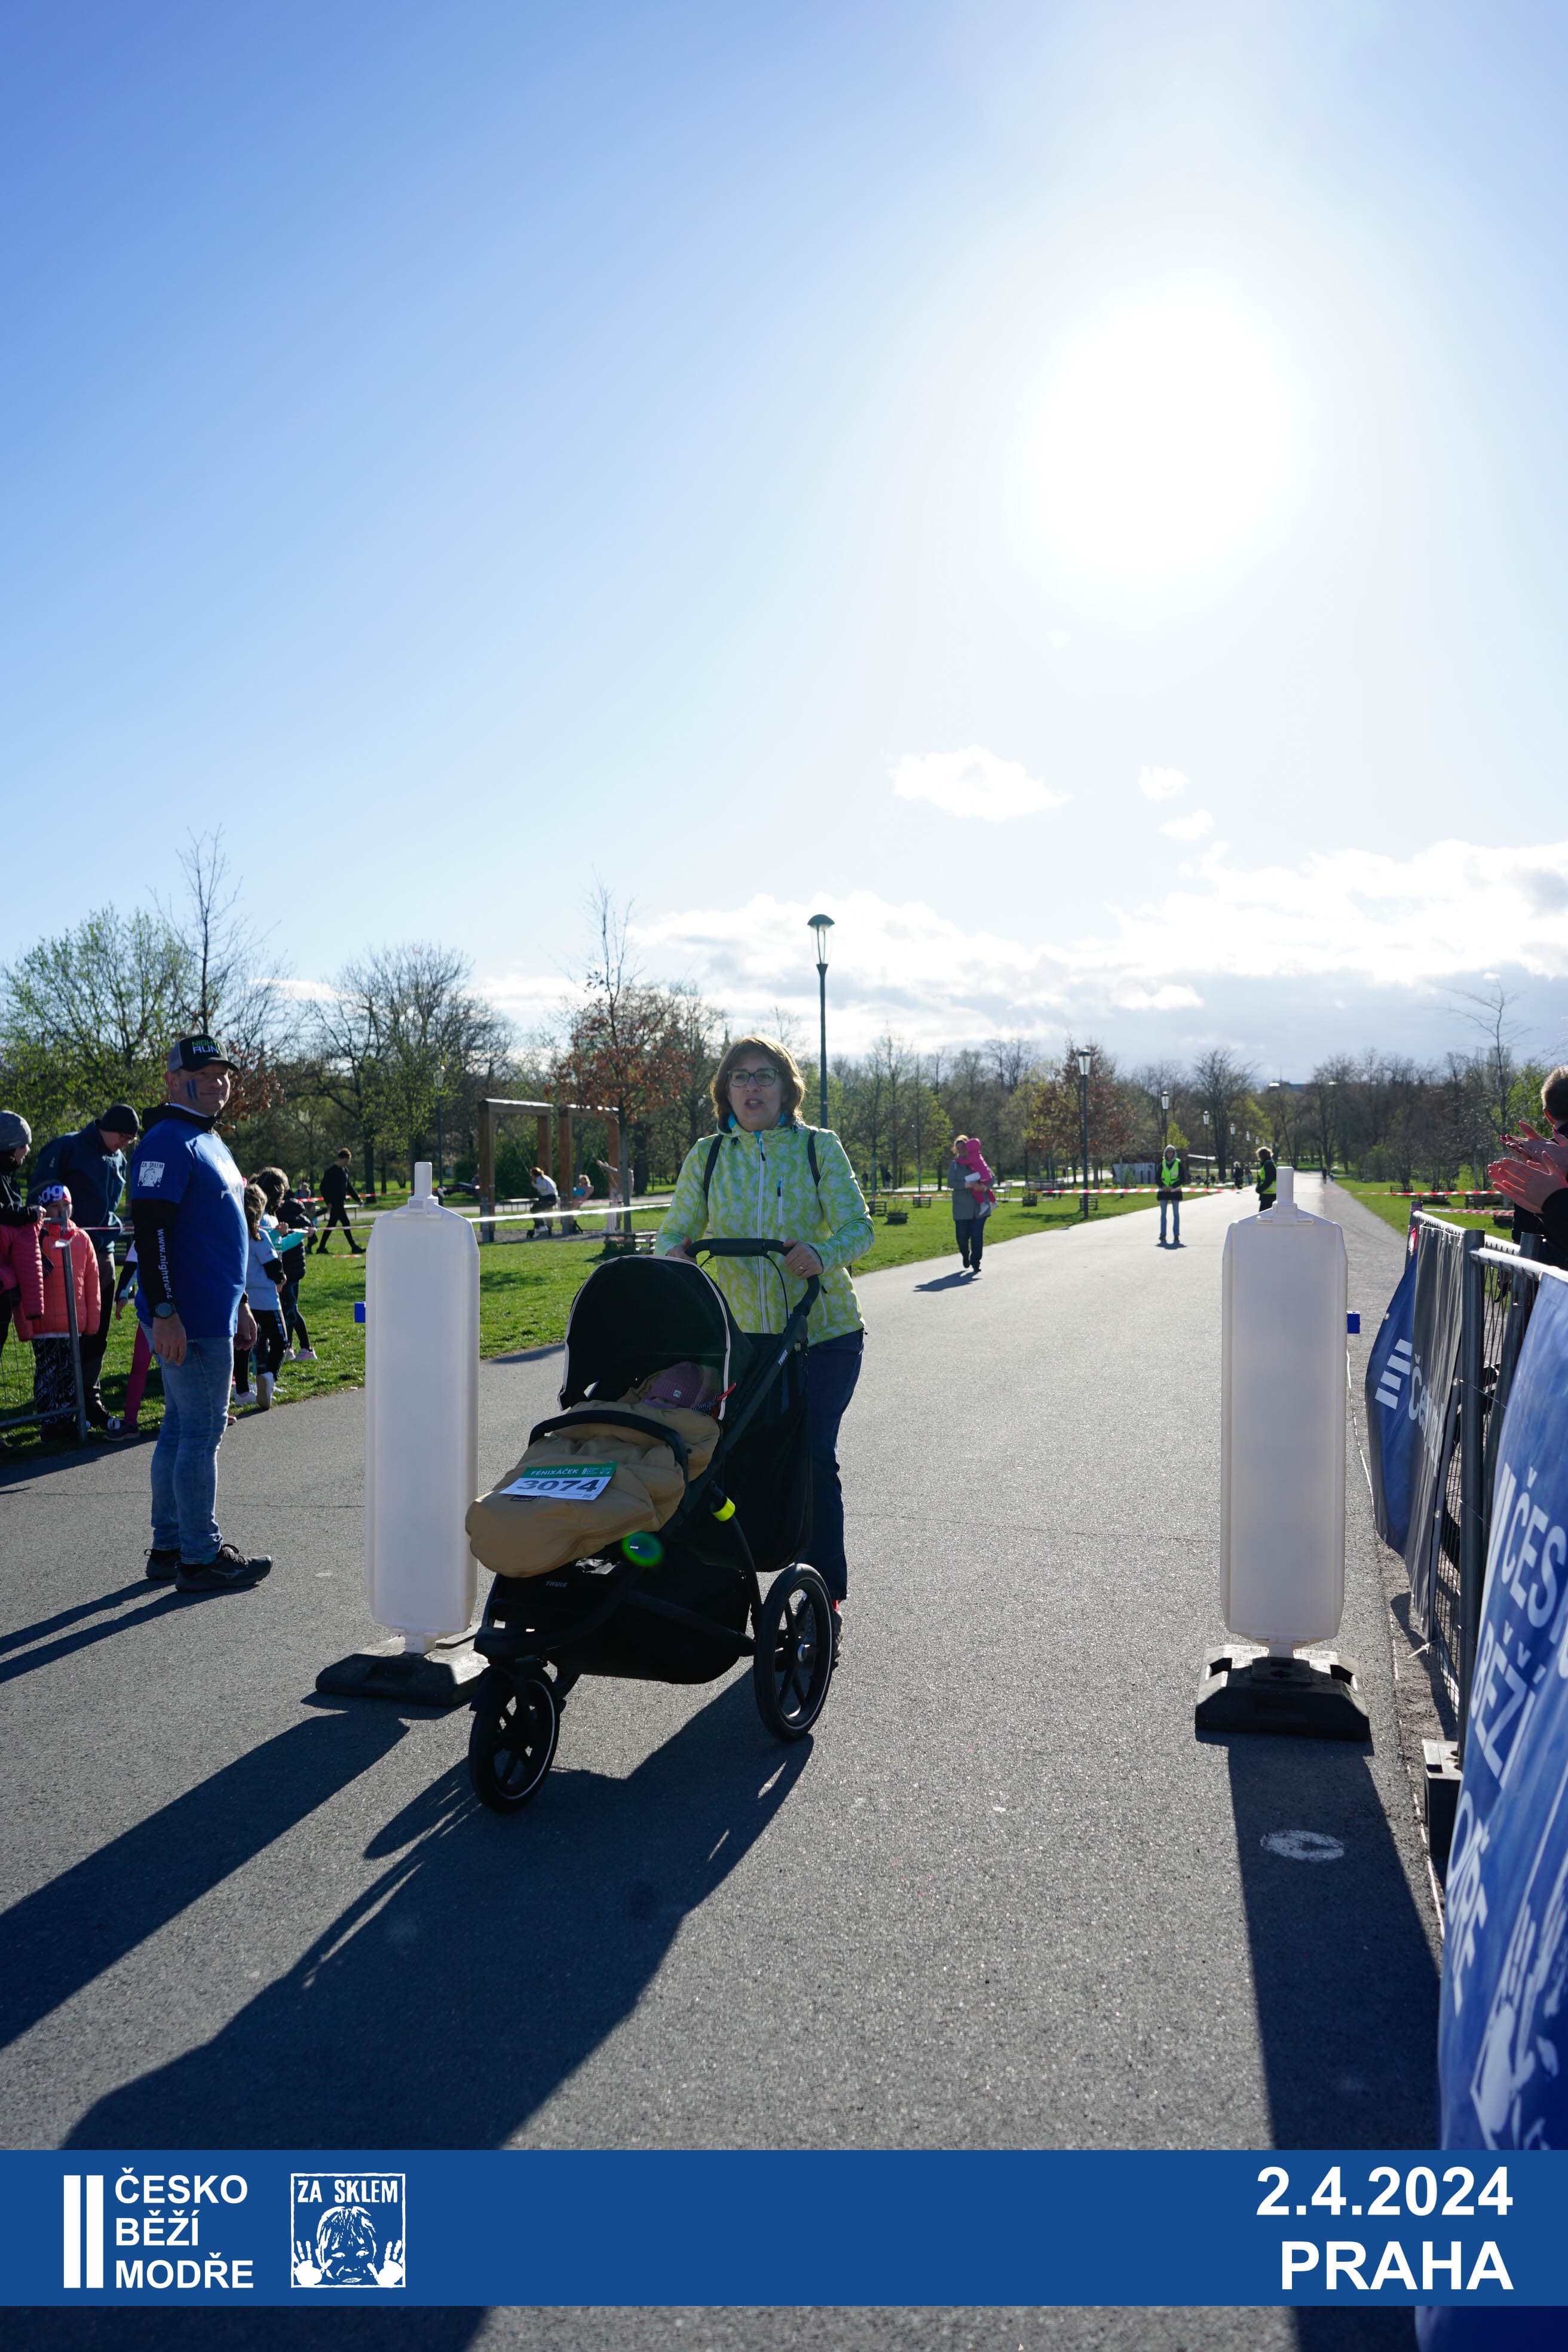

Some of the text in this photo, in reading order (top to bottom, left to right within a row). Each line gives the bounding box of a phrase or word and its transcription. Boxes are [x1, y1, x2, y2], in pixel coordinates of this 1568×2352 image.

[192, 1045, 219, 1054] RUN
[157, 1229, 173, 1300] www.nightrun.c
[516, 1479, 600, 1492] 3074
[531, 1468, 579, 1476] FÉNIXÁČEK
[1500, 1466, 1568, 1680] ČES
[1470, 1619, 1546, 1790] BĚŽÍ
[1446, 1790, 1490, 2017] ODŘE
